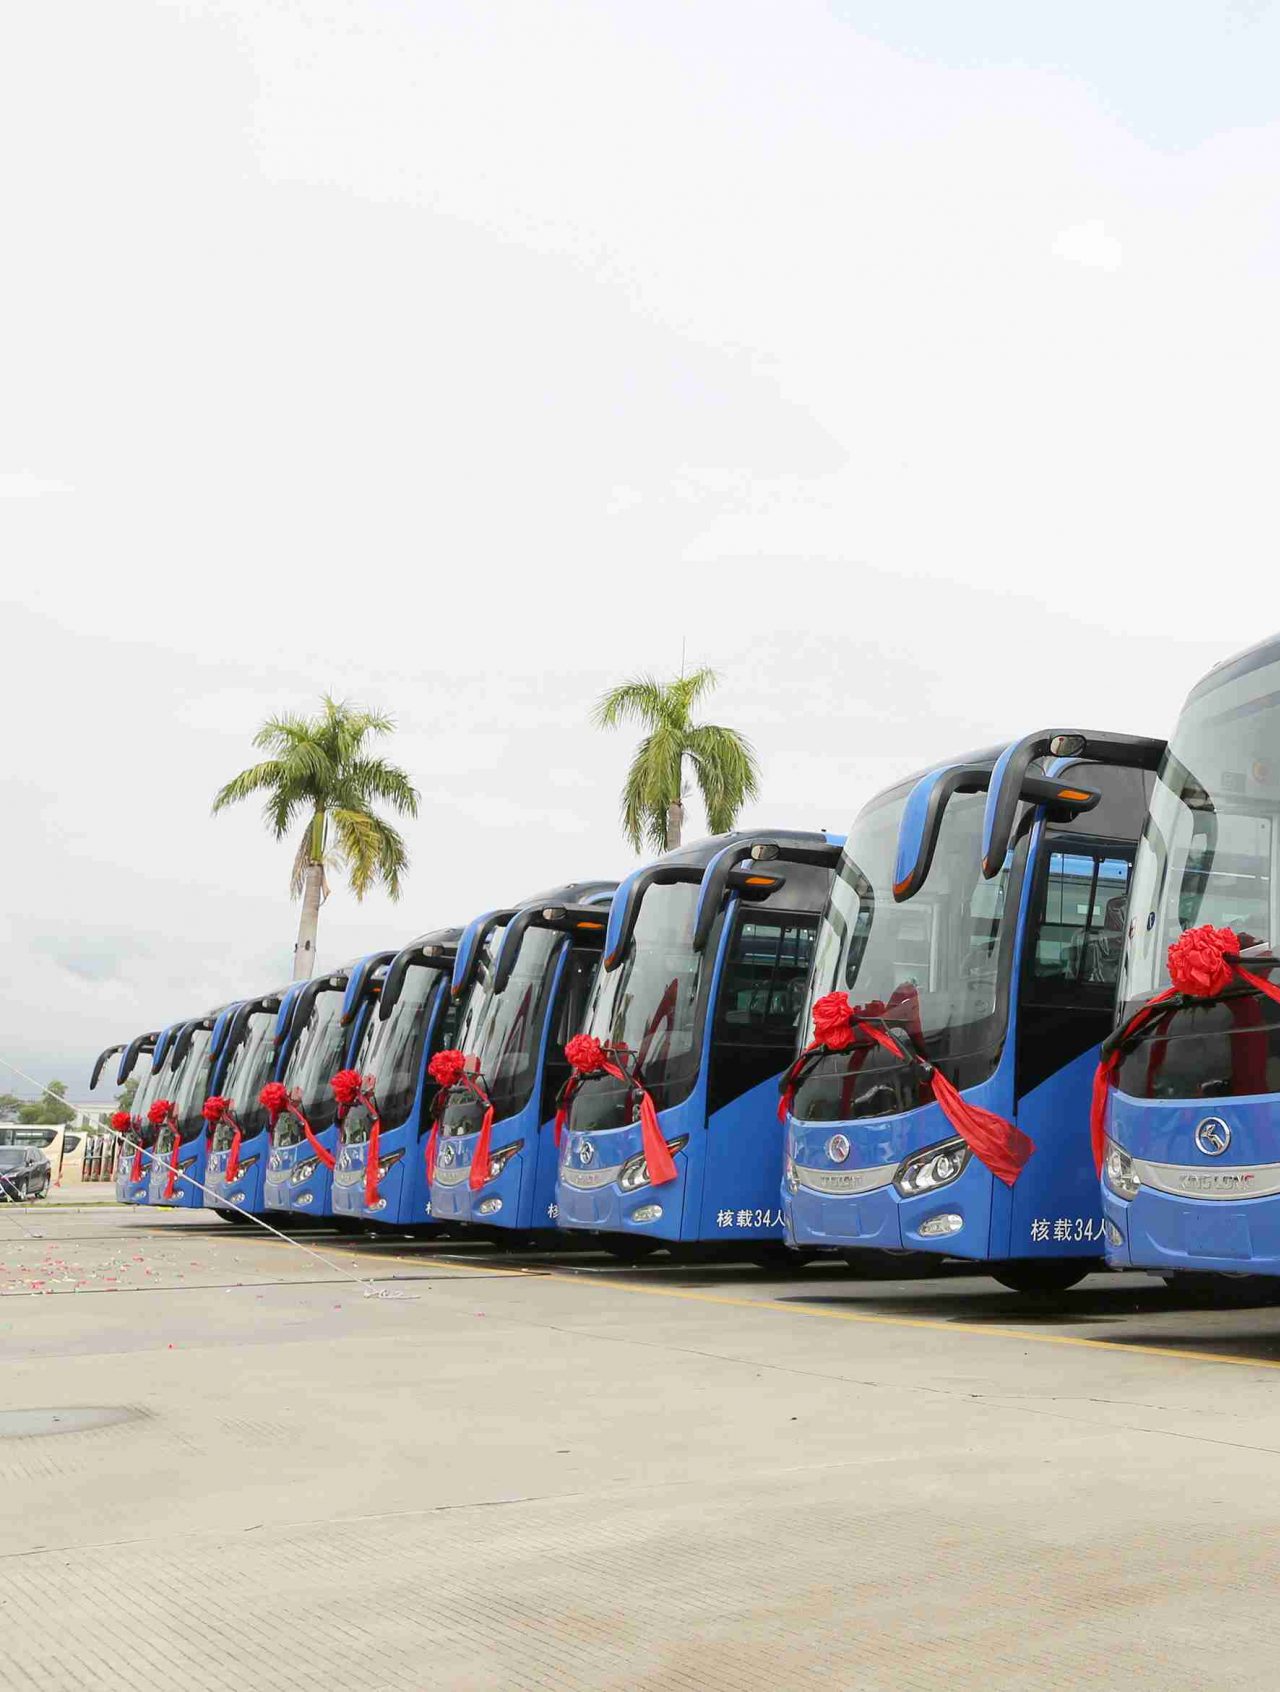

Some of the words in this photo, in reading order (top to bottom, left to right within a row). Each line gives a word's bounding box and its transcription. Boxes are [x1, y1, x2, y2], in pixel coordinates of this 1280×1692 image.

[716, 1209, 785, 1228] 核载34人
[1030, 1218, 1107, 1242] 核载34人
